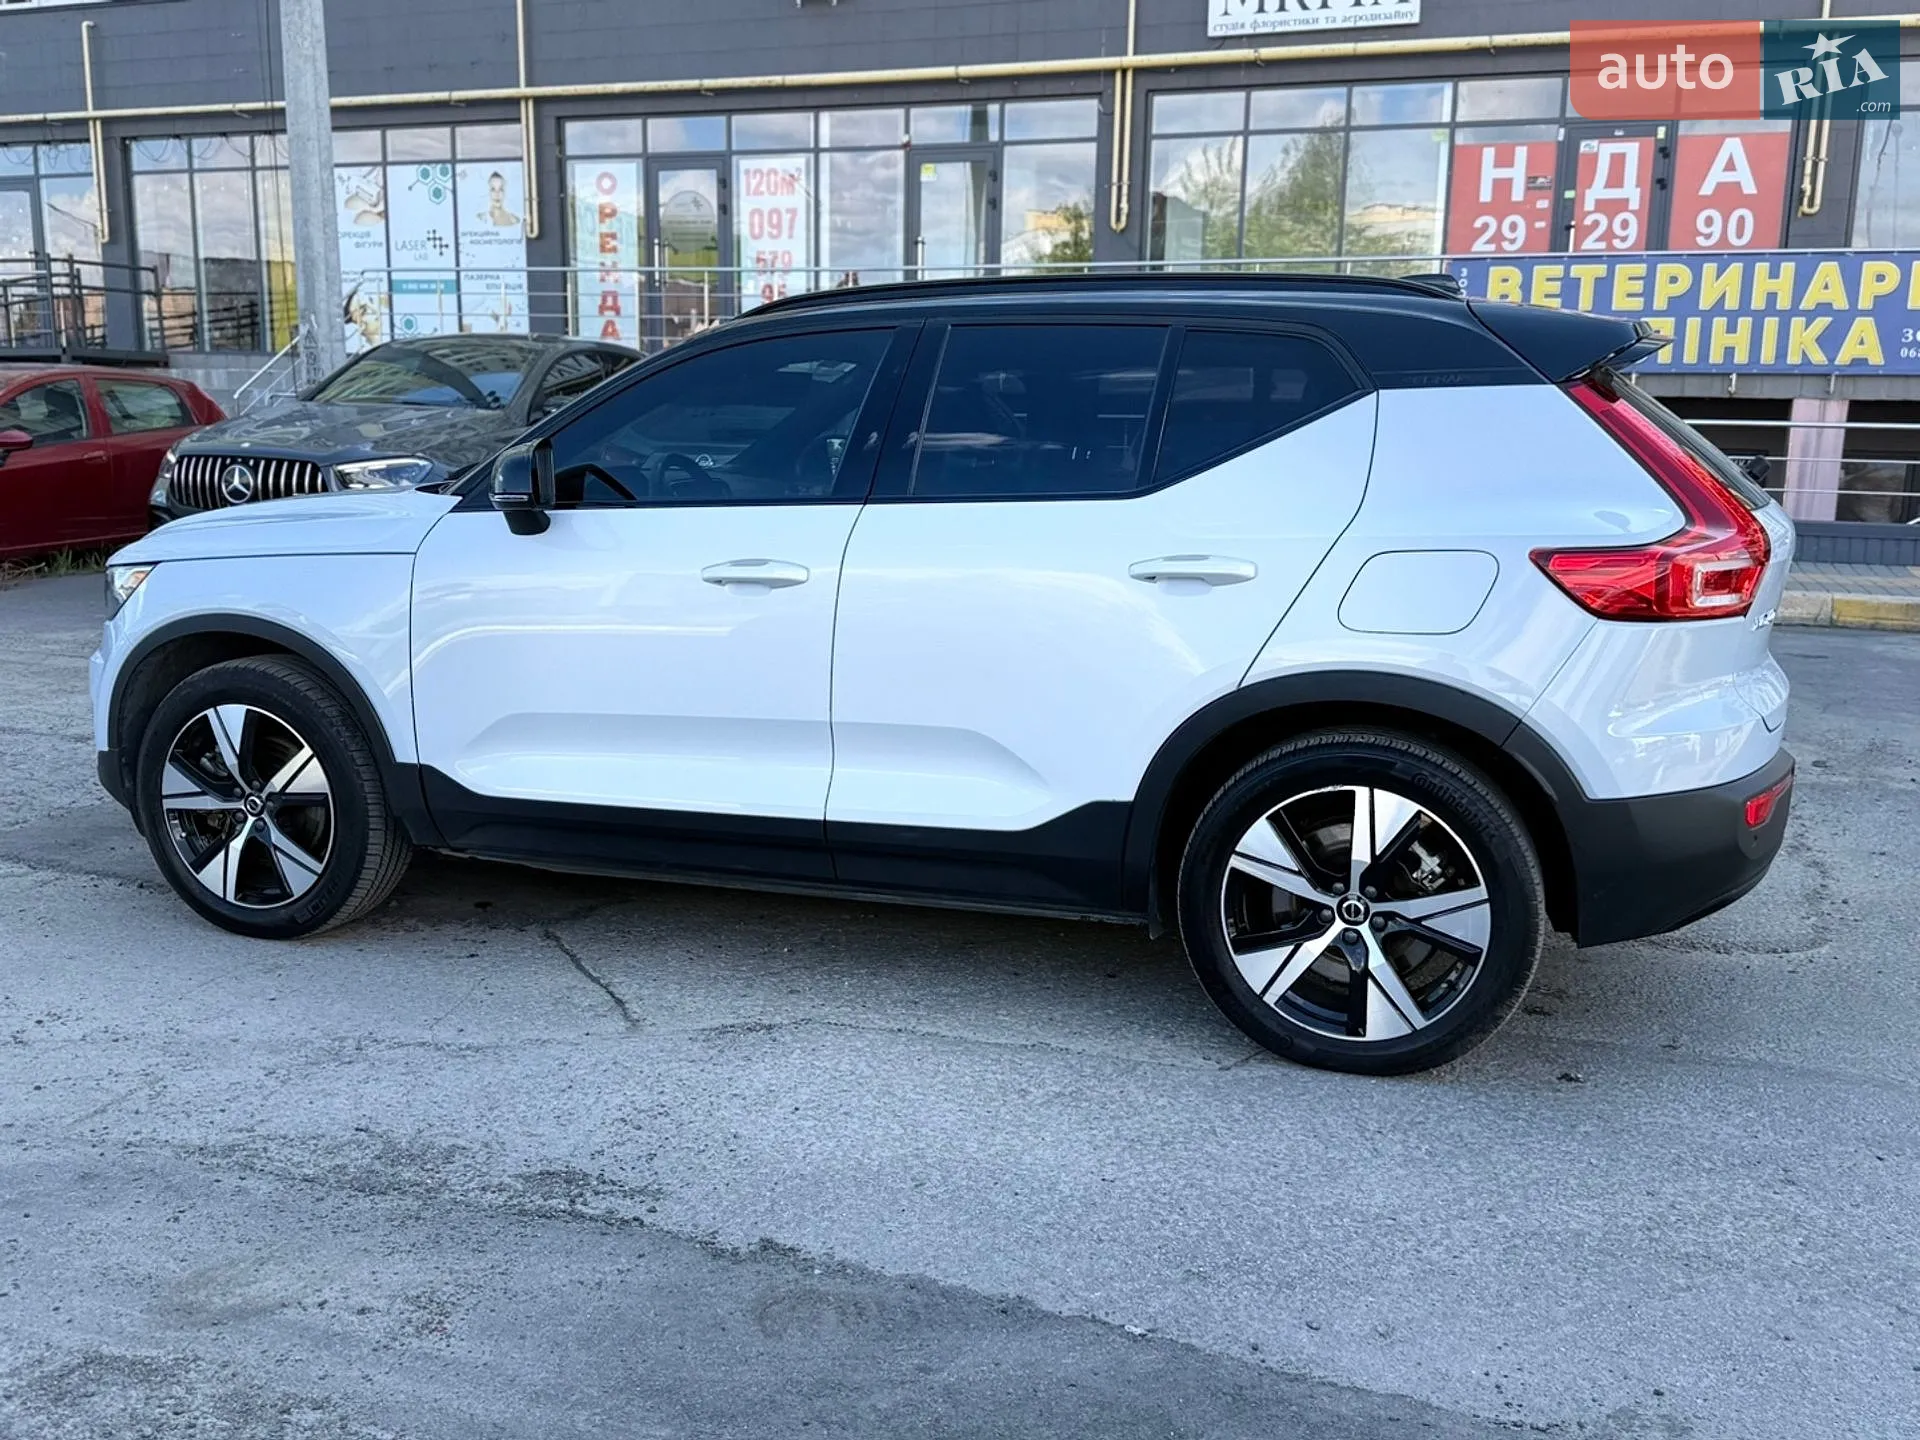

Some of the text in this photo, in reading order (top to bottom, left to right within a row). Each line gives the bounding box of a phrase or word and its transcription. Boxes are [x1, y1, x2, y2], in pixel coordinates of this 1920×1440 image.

[1325, 16, 1337, 24] та
[1584, 142, 1640, 211] Д
[748, 208, 798, 240] 097
[1471, 208, 1754, 252] 29 29 90
[394, 239, 427, 251] LASER
[1486, 260, 1920, 312] ВЕТЕРИНАР
